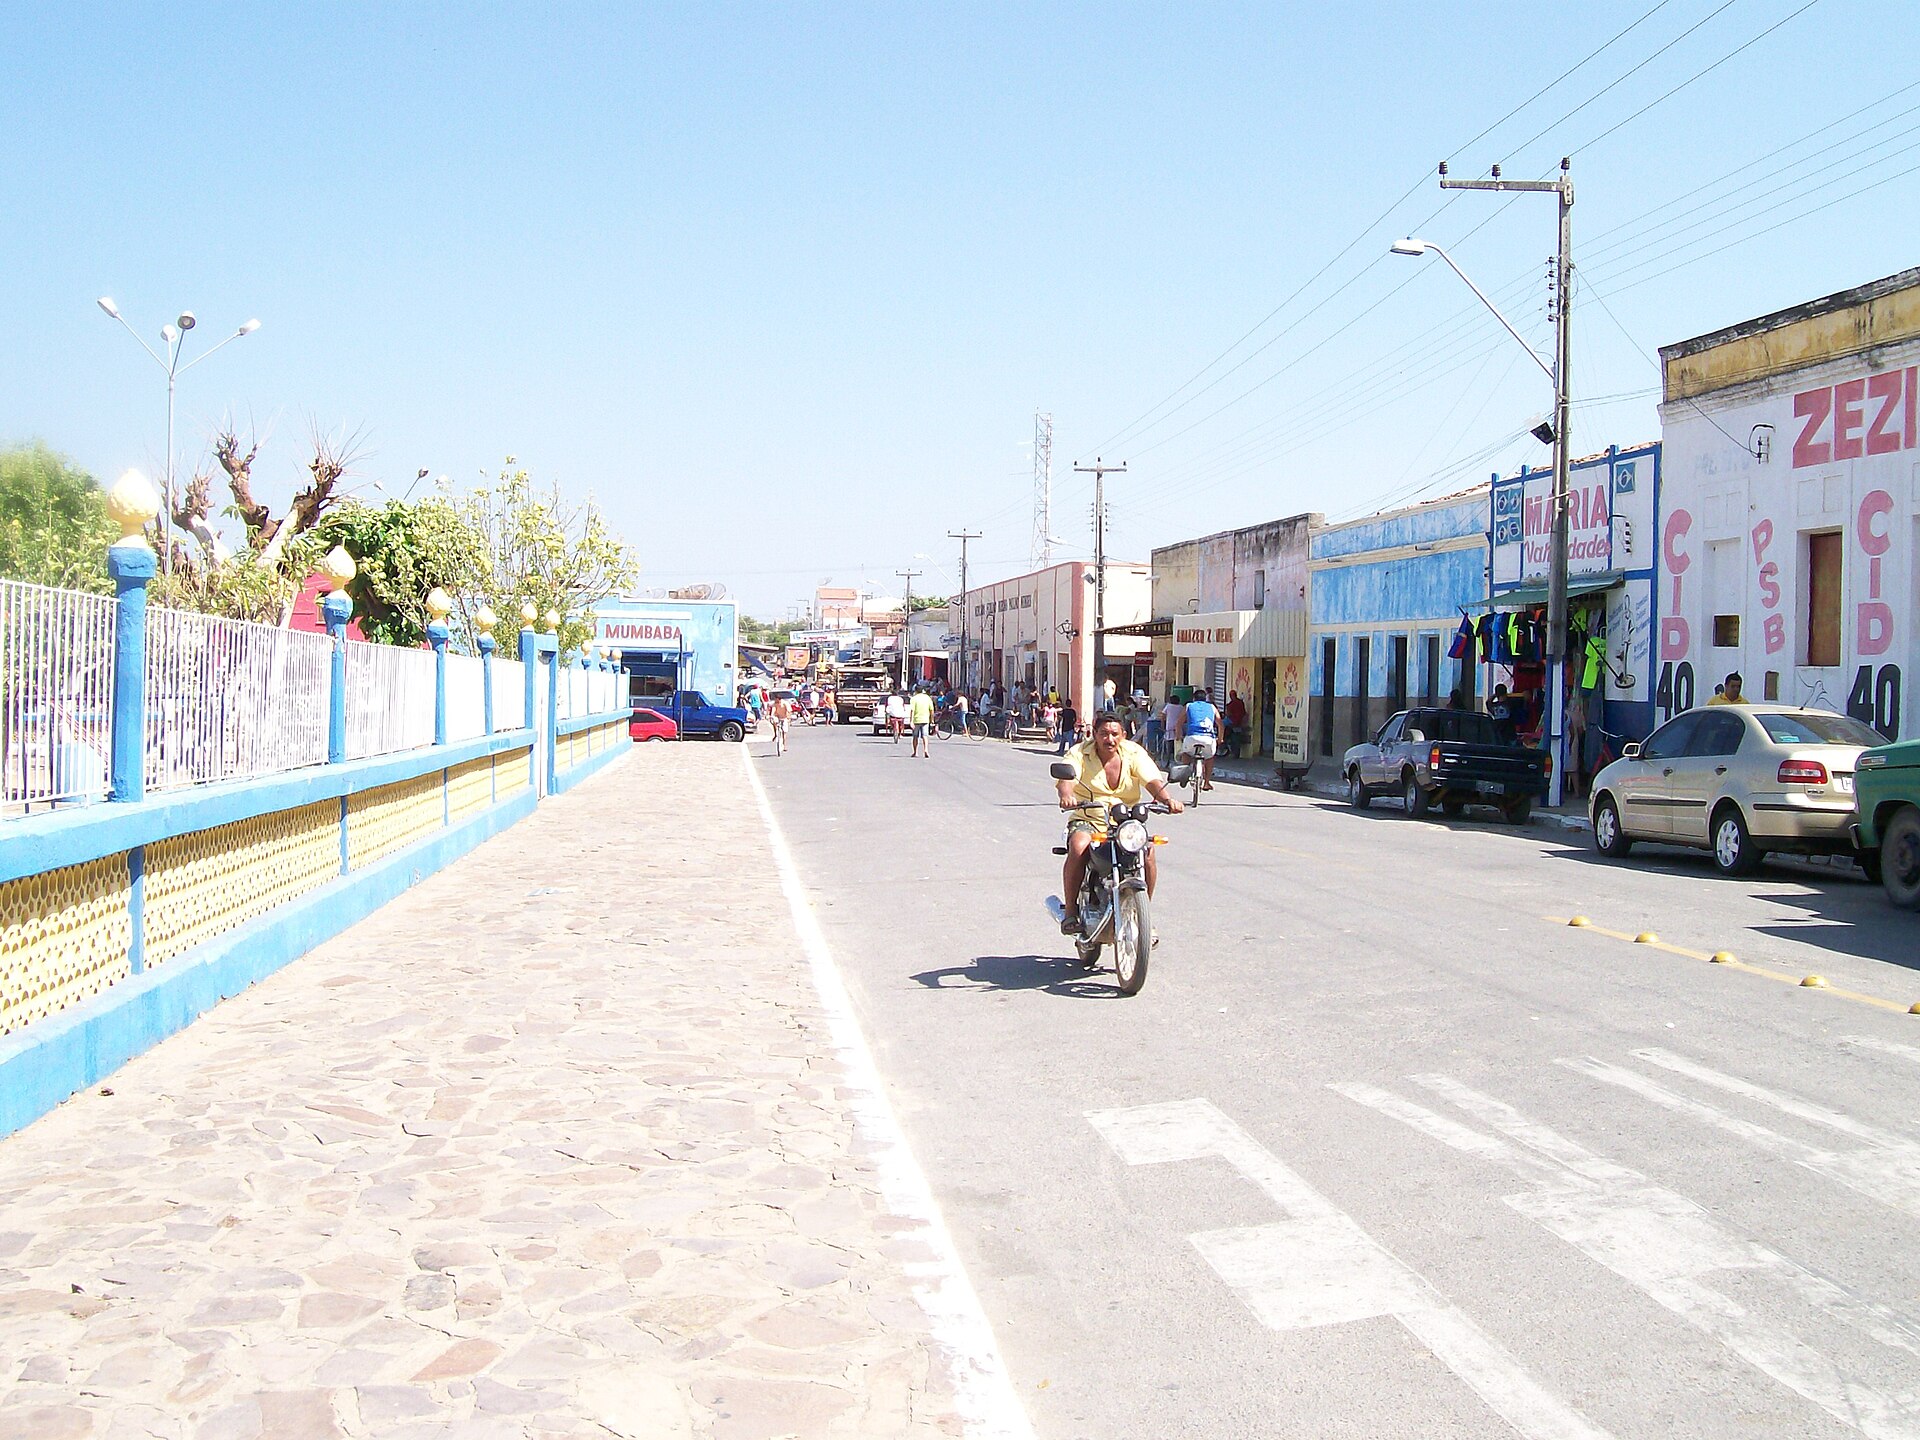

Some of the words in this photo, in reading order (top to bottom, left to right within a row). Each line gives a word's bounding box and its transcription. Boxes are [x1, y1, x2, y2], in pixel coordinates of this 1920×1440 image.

[1792, 366, 1918, 469] ZEZI
[1661, 509, 1693, 661] CID
[1752, 519, 1786, 655] PSB
[1857, 490, 1895, 656] CID
[605, 623, 681, 640] MUMBABA
[1657, 662, 1694, 721] 40
[1847, 664, 1901, 743] 40
